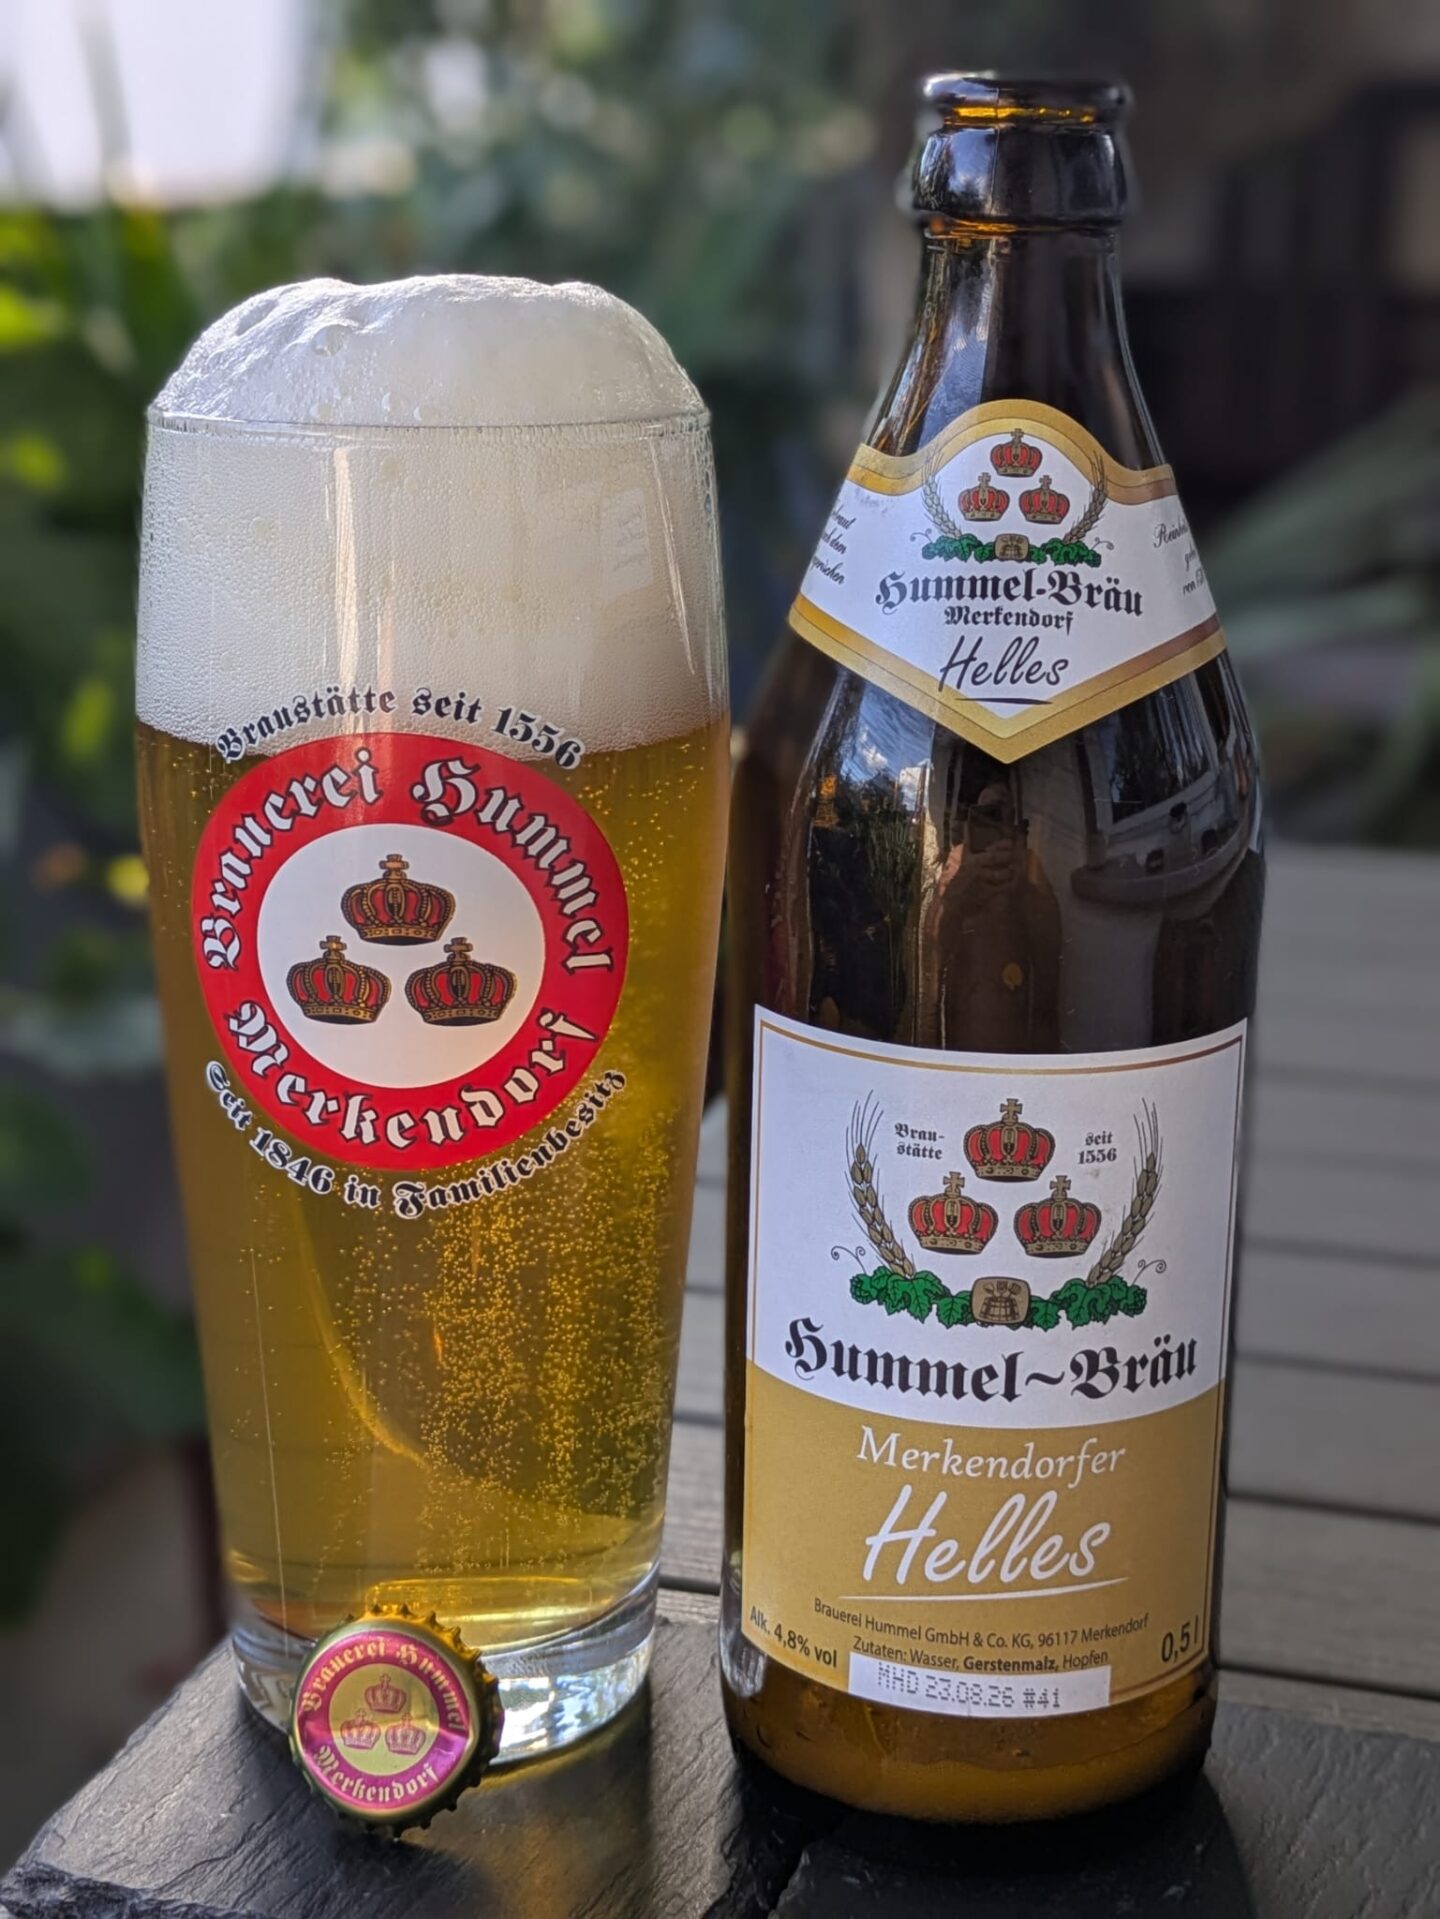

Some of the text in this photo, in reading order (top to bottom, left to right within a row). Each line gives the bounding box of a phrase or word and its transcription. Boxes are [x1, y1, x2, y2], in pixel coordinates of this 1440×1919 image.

[875, 567, 1144, 617] Hummel-Bräu
[944, 606, 1074, 635] Merkendorf
[938, 635, 1069, 692] Helles
[216, 687, 584, 770] Braustätte seit 1556
[202, 747, 614, 975] Brauerei Hummel
[227, 1000, 596, 1150] Merkendorf
[206, 1061, 628, 1219] Seit 1846 in Familienbesitz
[894, 1122, 945, 1142] Brau-
[896, 1140, 943, 1160] stätte
[1078, 1147, 1118, 1165] 1556
[1084, 1130, 1114, 1147] seit
[857, 1425, 1127, 1489] Merkendorfer
[861, 1483, 1112, 1585] Helles
[749, 1605, 837, 1668] Alk. 4,8% vol
[814, 1597, 1149, 1650] Brauerei Hummel GmbH & Co. KG, 96117 Merkendorf
[1161, 1622, 1191, 1663] 0,5
[853, 1635, 1108, 1673] Zutaten: Wasser, Gerstenmalz, Hopfen
[301, 1636, 467, 1731] Brauerei Hummel
[878, 1661, 919, 1694] MHD
[1022, 1687, 1061, 1709] #41
[313, 1745, 439, 1803] Merkendorf
